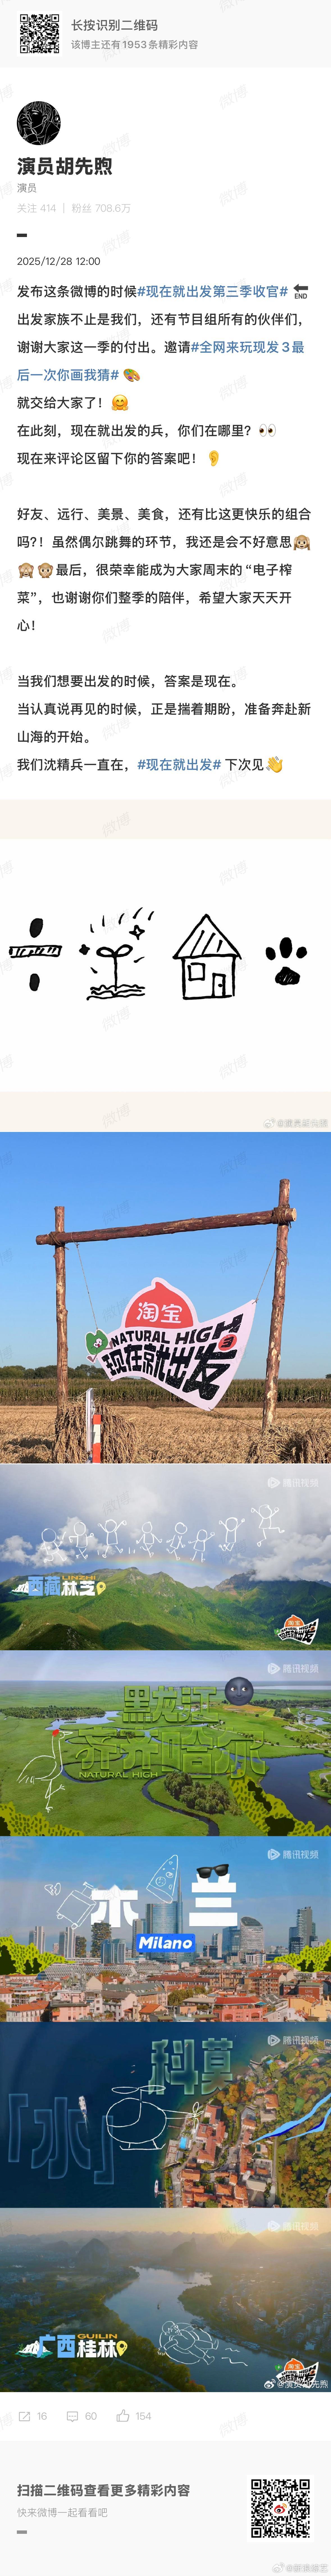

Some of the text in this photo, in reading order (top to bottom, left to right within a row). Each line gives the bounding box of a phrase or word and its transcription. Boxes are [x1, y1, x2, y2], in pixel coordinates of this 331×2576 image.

[71, 19, 157, 31] 长按识别二维码
[17, 157, 112, 175] 演员胡先煦
[17, 183, 36, 192] 演员
[17, 204, 36, 213] 关注
[72, 204, 91, 213] 粉丝
[96, 204, 131, 213] 708.6万
[17, 256, 72, 266] 2025/12/28
[17, 285, 288, 297] 发布这条微博的时候#现在就出发第三季收官#
[18, 313, 301, 326] 出发家族不止是我们，还有节目组所有的伙伴们，
[17, 369, 119, 381] 后一次你画我猜#
[17, 396, 101, 409] 就交给大家了！
[17, 452, 195, 464] 现在来评论区留下你的答案吧！
[17, 508, 311, 521] 好友、远行、美景、美食，还有比这更快乐的组合
[17, 619, 34, 631] 心！
[18, 675, 236, 688] 当我们想要出发的时候，答案是现在。
[18, 703, 311, 716] 当认真说再见的时候，正是揣着期盼，准备奔赴新
[18, 730, 88, 743] 山海的开始。
[136, 1302, 182, 1323] 淘宝
[111, 1313, 243, 1347] NATURAL HIGH
[101, 1342, 238, 1400] 现在就出发
[17, 2484, 190, 2496] 扫描二维码查看更多精彩内容
[17, 2508, 107, 2517] 快来微博一起看看吧
